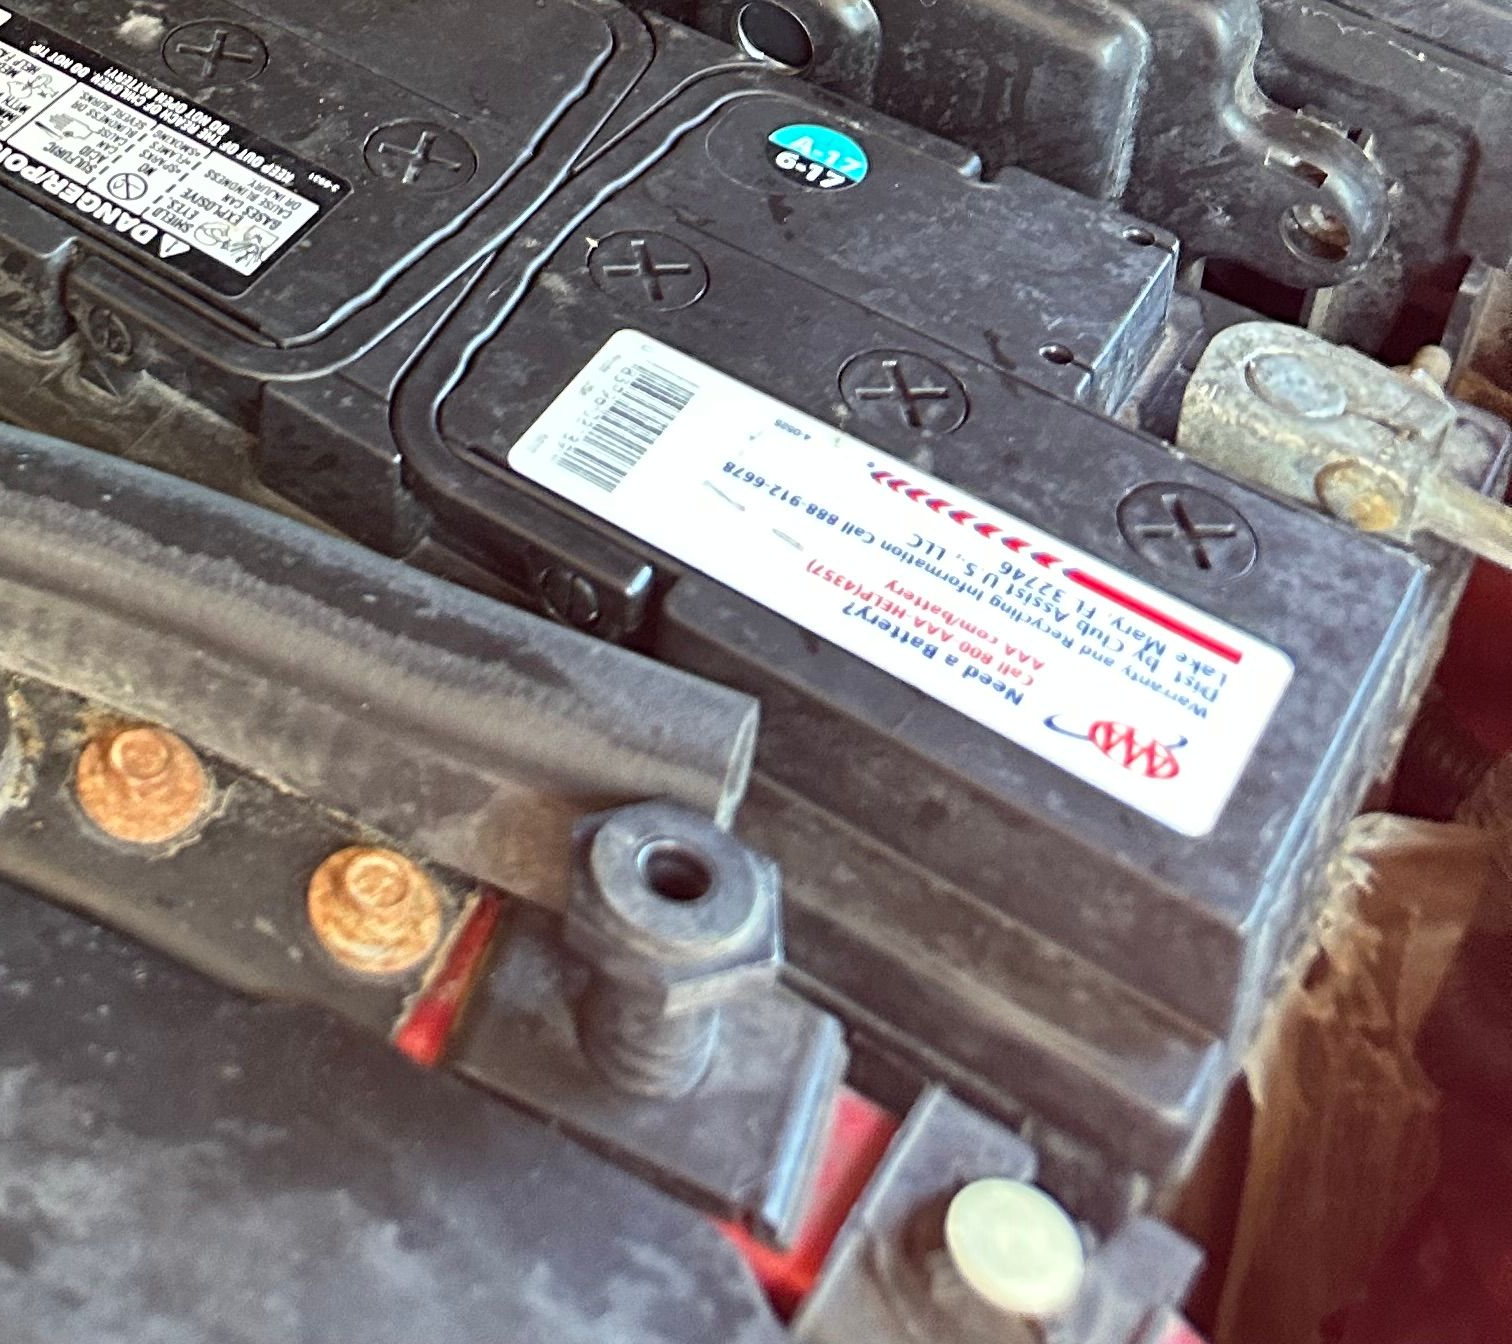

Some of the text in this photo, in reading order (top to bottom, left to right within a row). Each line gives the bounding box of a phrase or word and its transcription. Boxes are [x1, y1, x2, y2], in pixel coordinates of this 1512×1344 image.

[11, 57, 41, 75] HELP
[44, 50, 76, 70] NOT
[66, 61, 93, 78] DO
[0, 95, 32, 115] WITH
[139, 99, 166, 116] OF
[151, 91, 191, 115] OPEN
[69, 99, 140, 139] BLINDNESS OR
[109, 107, 149, 130] SEVERE
[156, 107, 204, 136] REACH
[182, 107, 214, 127] NOT
[204, 118, 233, 136] DO
[94, 125, 130, 147] CAUSE
[94, 138, 120, 155] CAN
[193, 126, 226, 147] THE
[215, 138, 243, 156] OF
[40, 140, 99, 175] SULFURIC
[76, 144, 110, 165] ACID
[232, 147, 268, 169] OUT
[787, 135, 864, 173] A-17
[134, 161, 158, 177] NO
[257, 160, 297, 184] KEEP
[775, 150, 846, 189] 6-17
[177, 187, 246, 226] EXPLOSIVE
[200, 167, 294, 220] CAUSE BLINDNESS
[282, 197, 303, 211] OR
[148, 205, 195, 234] SHIELD
[219, 193, 284, 231] GASES CAN
[905, 531, 947, 562] LLC
[720, 458, 1212, 720] Warranty and Recycling Information Call 888-912-6678
[994, 558, 1067, 604] 32746
[1001, 581, 1071, 626] Assist
[1070, 597, 1098, 620] FL
[1071, 618, 1127, 655] Club
[839, 595, 1026, 707] Need a Battery?
[1128, 644, 1163, 673] by
[994, 659, 1036, 689] Call
[1171, 648, 1229, 688] Lake
[1085, 717, 1184, 783] AAA
